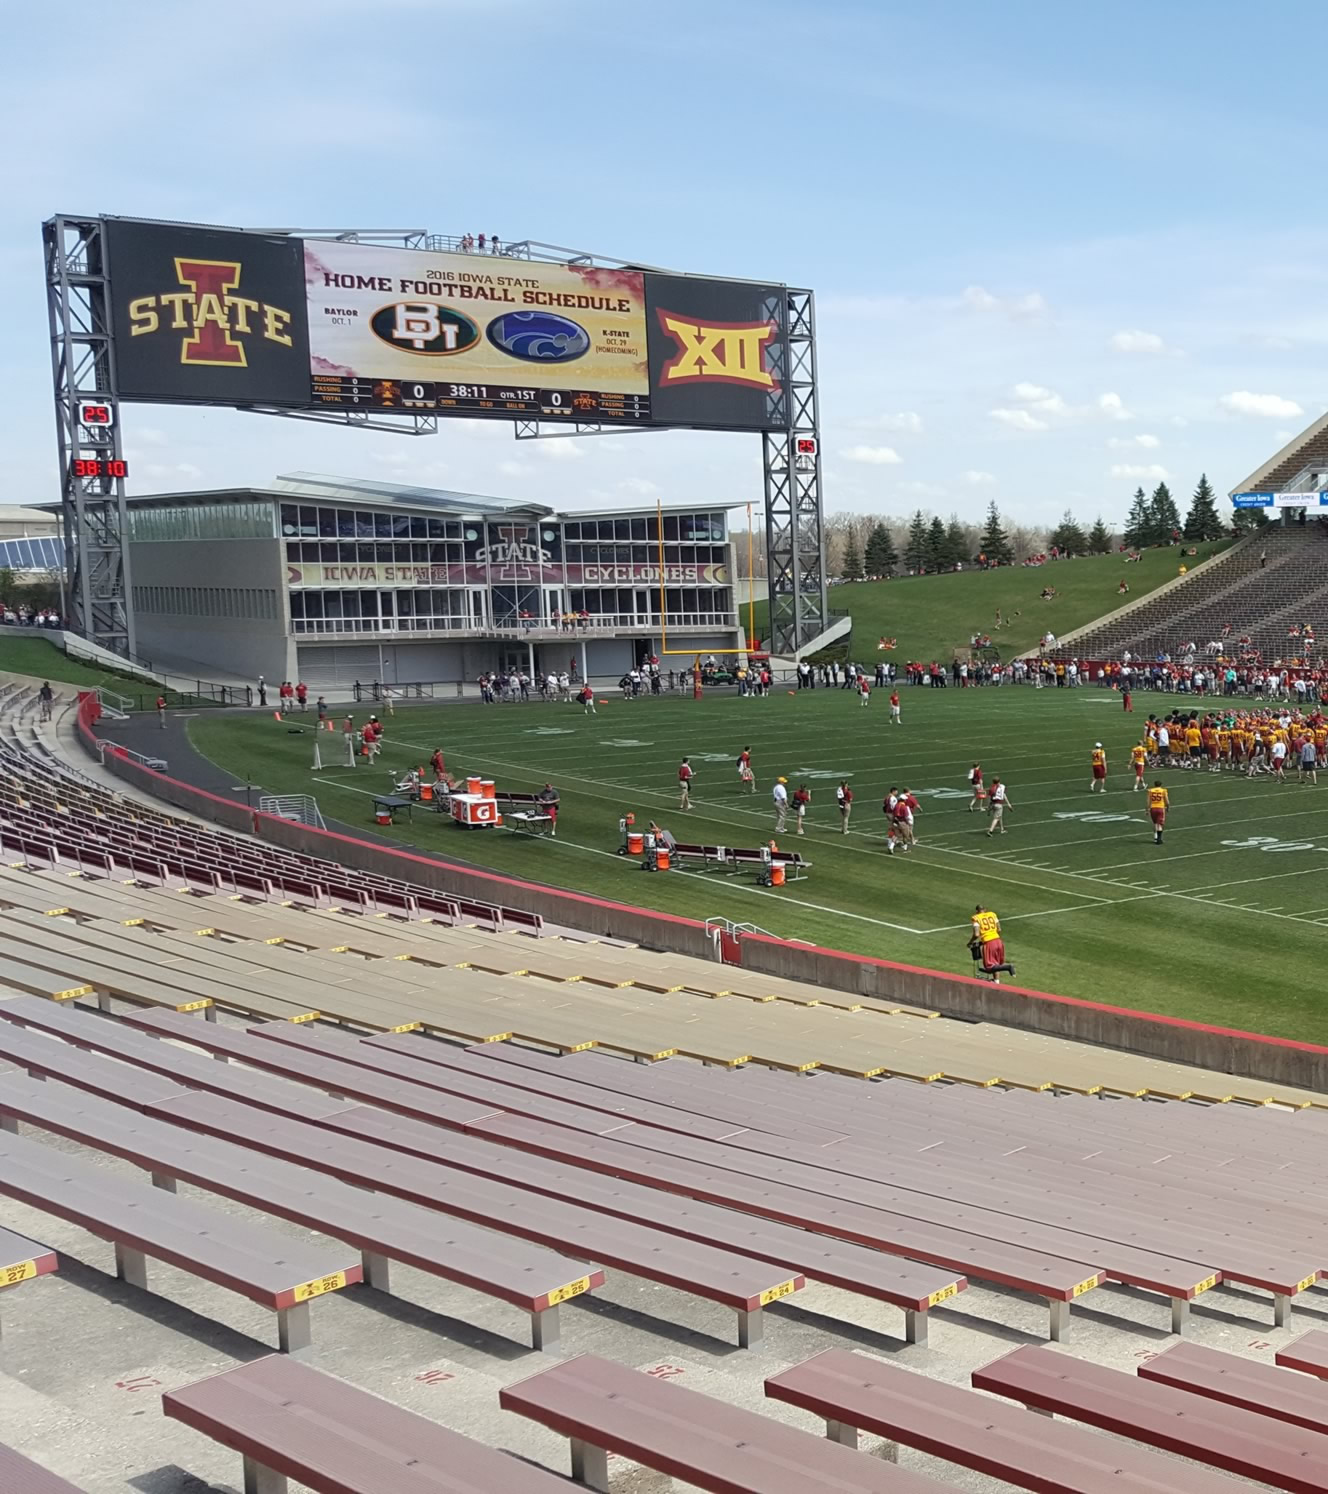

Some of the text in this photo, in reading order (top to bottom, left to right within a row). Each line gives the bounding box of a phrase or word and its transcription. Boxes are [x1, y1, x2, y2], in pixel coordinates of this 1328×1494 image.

[427, 270, 540, 289] 2016 IOWA STATE
[324, 273, 631, 313] HOME FOOTBALL SCHEDULE
[324, 307, 358, 317] BAYLOR
[129, 294, 292, 347] STATE
[603, 330, 630, 338] K-STATE
[595, 345, 638, 357] (HOMECOMING)
[665, 317, 774, 387] XII
[314, 385, 341, 393] PASSING
[414, 385, 424, 398] 0
[450, 385, 487, 398] 38:11
[516, 390, 535, 400] 1ST
[552, 393, 561, 406] 0
[85, 407, 107, 422] 25
[799, 440, 814, 452] 25
[75, 460, 125, 477] 38:10
[1235, 494, 1256, 502] Greater
[475, 543, 552, 569] STATE
[323, 566, 447, 581] IOWA STATE
[584, 567, 697, 580] CYCLONES
[1151, 792, 1161, 802] 55
[477, 805, 491, 819] G
[1220, 836, 1315, 852] 30
[982, 916, 996, 931] 99
[6, 1263, 26, 1273] ROW
[8, 1268, 26, 1282] 27
[322, 1275, 338, 1283] ROW
[323, 1280, 338, 1291] 26
[572, 1284, 584, 1295] 25
